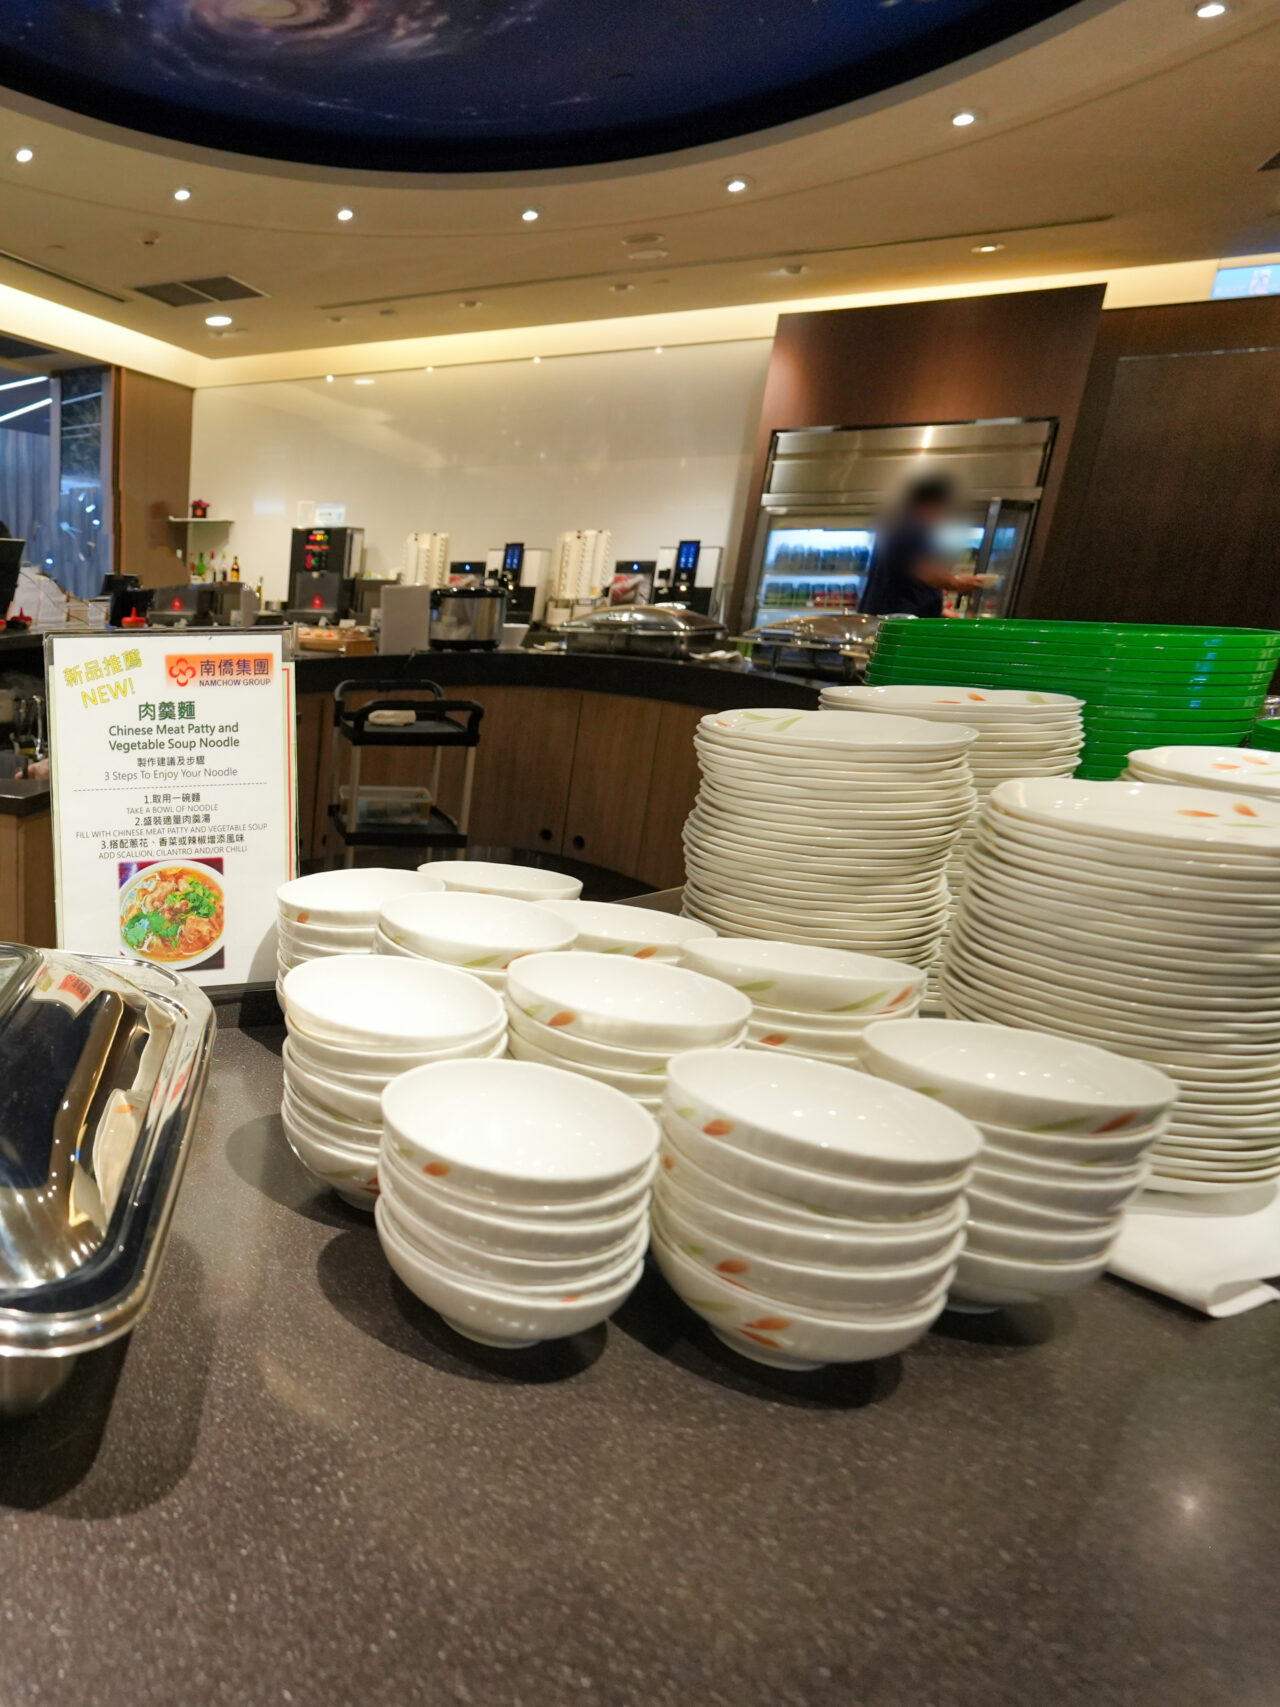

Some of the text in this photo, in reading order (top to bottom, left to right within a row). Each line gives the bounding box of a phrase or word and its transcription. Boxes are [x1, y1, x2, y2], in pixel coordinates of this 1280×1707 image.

[63, 648, 142, 687] 新品推薦
[199, 658, 269, 677] 南僑集團
[199, 678, 271, 687] NAMCHOW GROUP
[81, 677, 136, 708] NEW!
[138, 700, 196, 721] 肉羹麵
[108, 722, 239, 736] Chinese Meat Patty and
[108, 736, 240, 753] Vegetable Soup Noodle
[136, 755, 206, 767] 製作建議及步驟
[104, 767, 238, 782] 3 Steps To Enjoy Your Noodle
[187, 804, 219, 812] NOODLE
[75, 831, 90, 839] FILL
[91, 830, 111, 838] WITH
[112, 829, 144, 837] CHINESE
[145, 828, 166, 836] MEAT
[167, 826, 189, 834] PATTY
[207, 824, 246, 832] VEGETABLE
[248, 823, 268, 831] SOUP
[156, 847, 192, 857] CILANTRO
[193, 846, 225, 855] AND/OR
[225, 845, 248, 853] CHILLI
